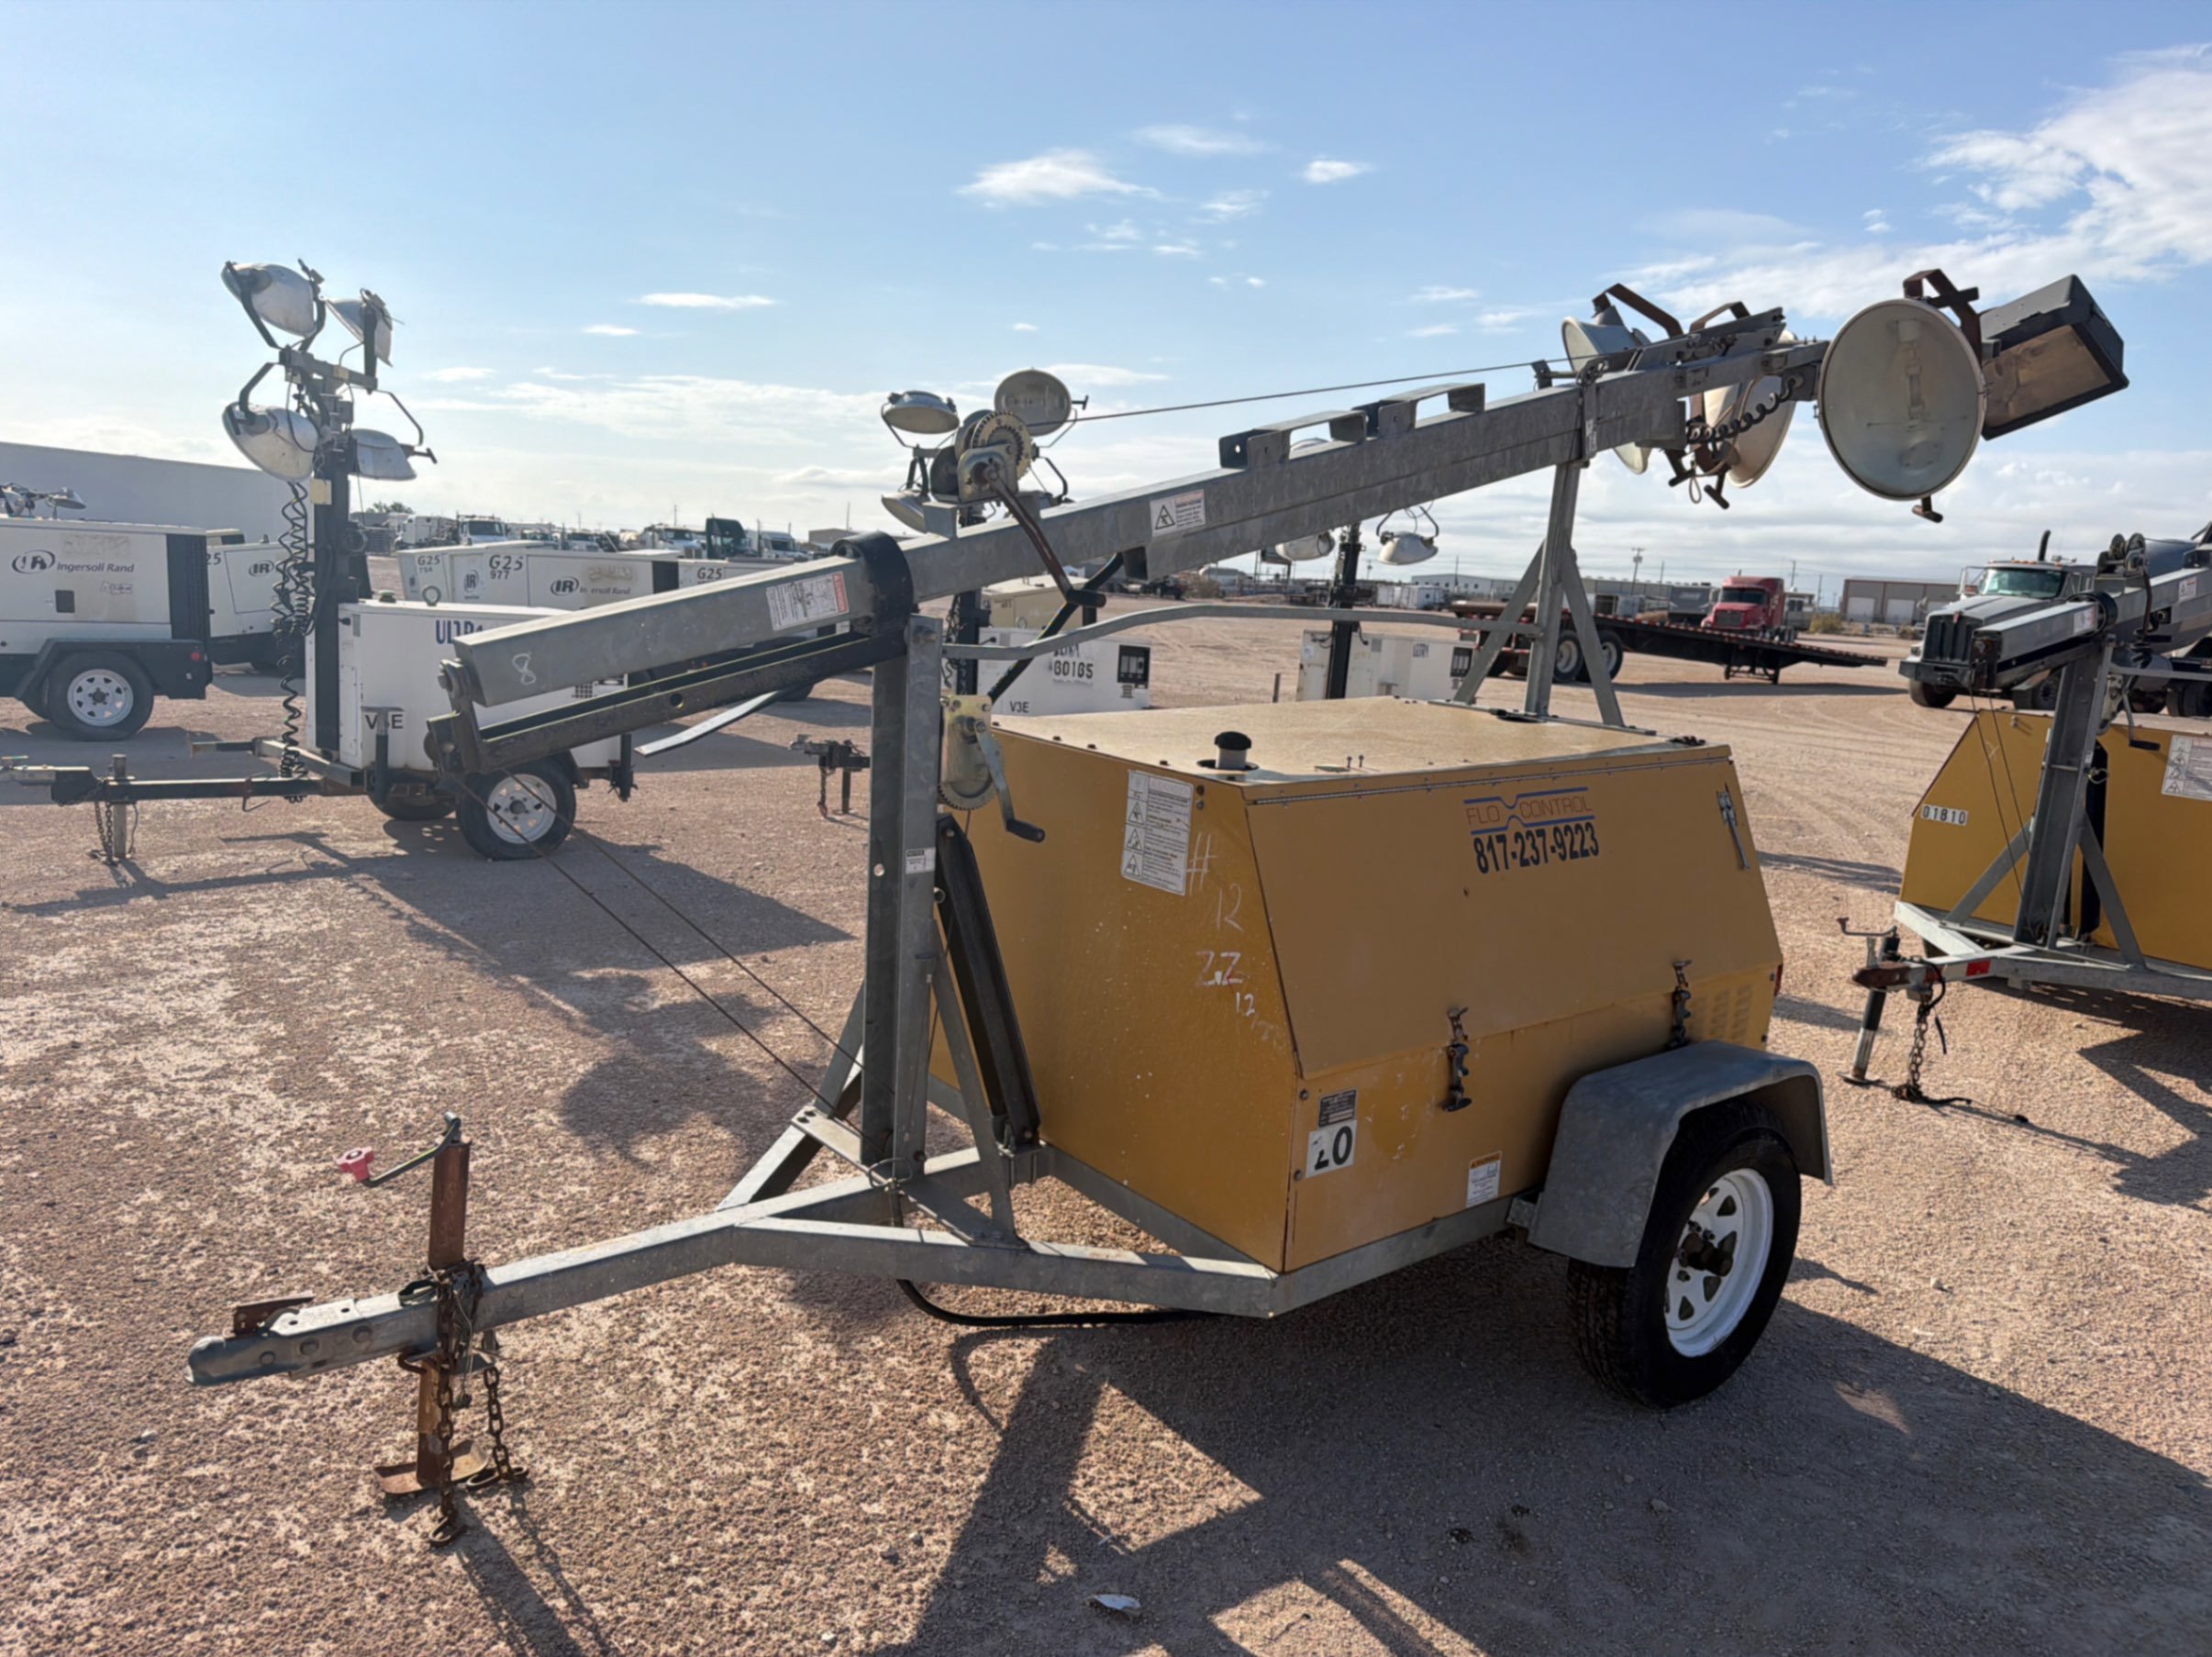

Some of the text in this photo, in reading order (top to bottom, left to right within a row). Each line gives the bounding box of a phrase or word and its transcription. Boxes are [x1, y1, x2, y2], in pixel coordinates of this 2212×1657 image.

[57, 562, 135, 573] Ingersoll Rand
[417, 555, 440, 566] G25
[489, 554, 523, 571] G25
[490, 570, 509, 580] 977
[697, 567, 722, 580] G25
[512, 652, 537, 685] 8
[1010, 701, 1029, 713] V3E
[365, 714, 404, 729] VE
[1465, 795, 1593, 825] FLO CONTROL
[1922, 806, 1966, 825] 01810
[1473, 821, 1599, 874] 817-237-9223
